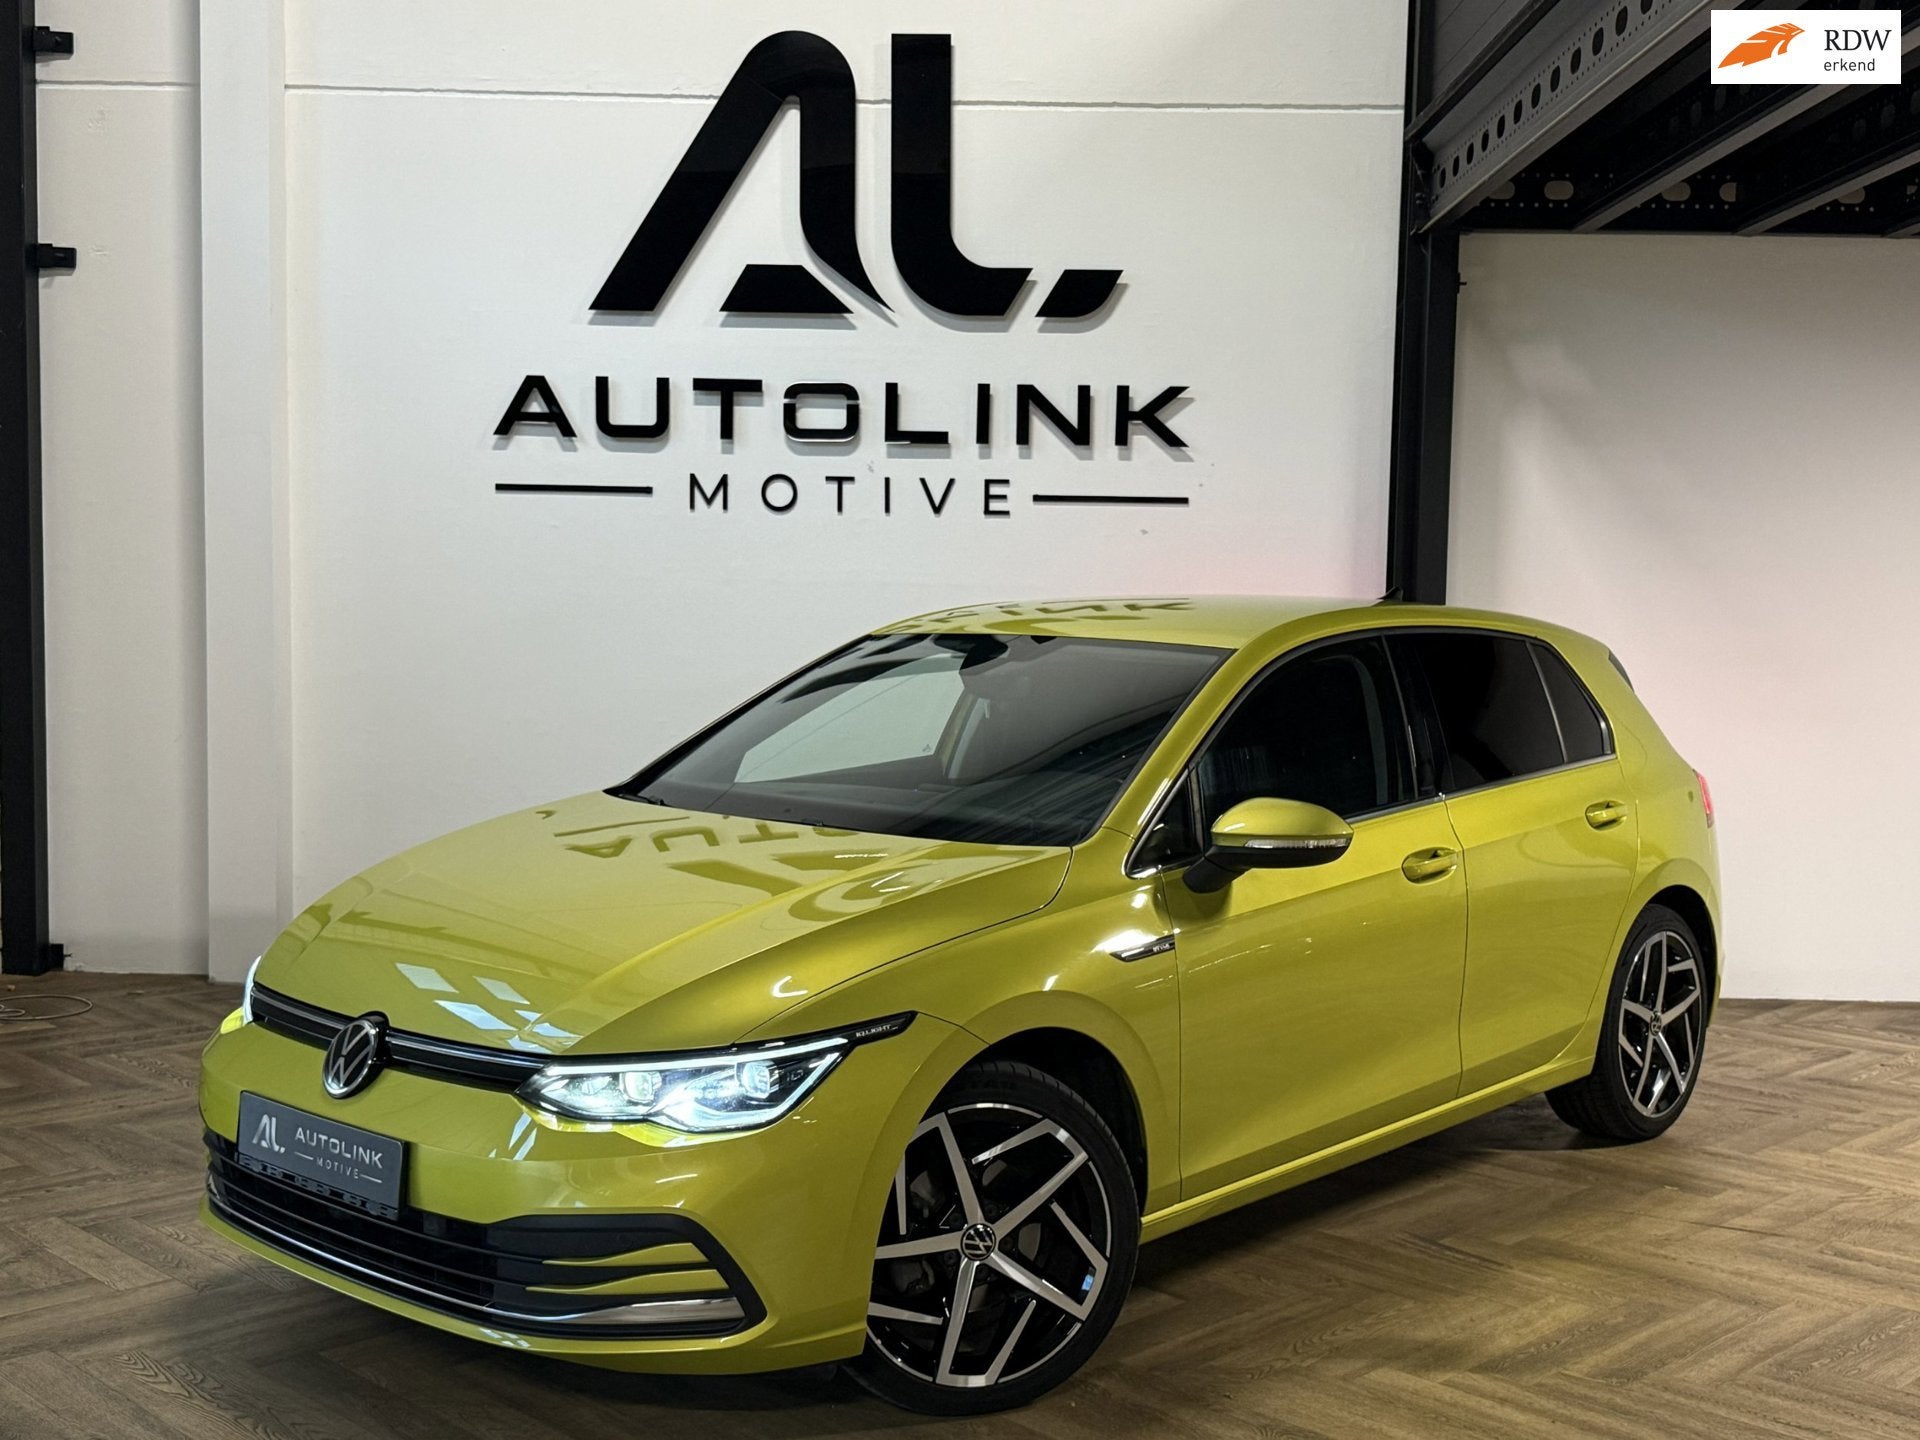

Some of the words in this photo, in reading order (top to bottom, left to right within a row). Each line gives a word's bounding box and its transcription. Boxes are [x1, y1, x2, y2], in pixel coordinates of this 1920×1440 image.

[493, 374, 1190, 448] AUTOLINK
[689, 472, 1012, 517] MOTIVE
[294, 1126, 383, 1169] AUTOLINK
[316, 1156, 359, 1179] MOTIVE
